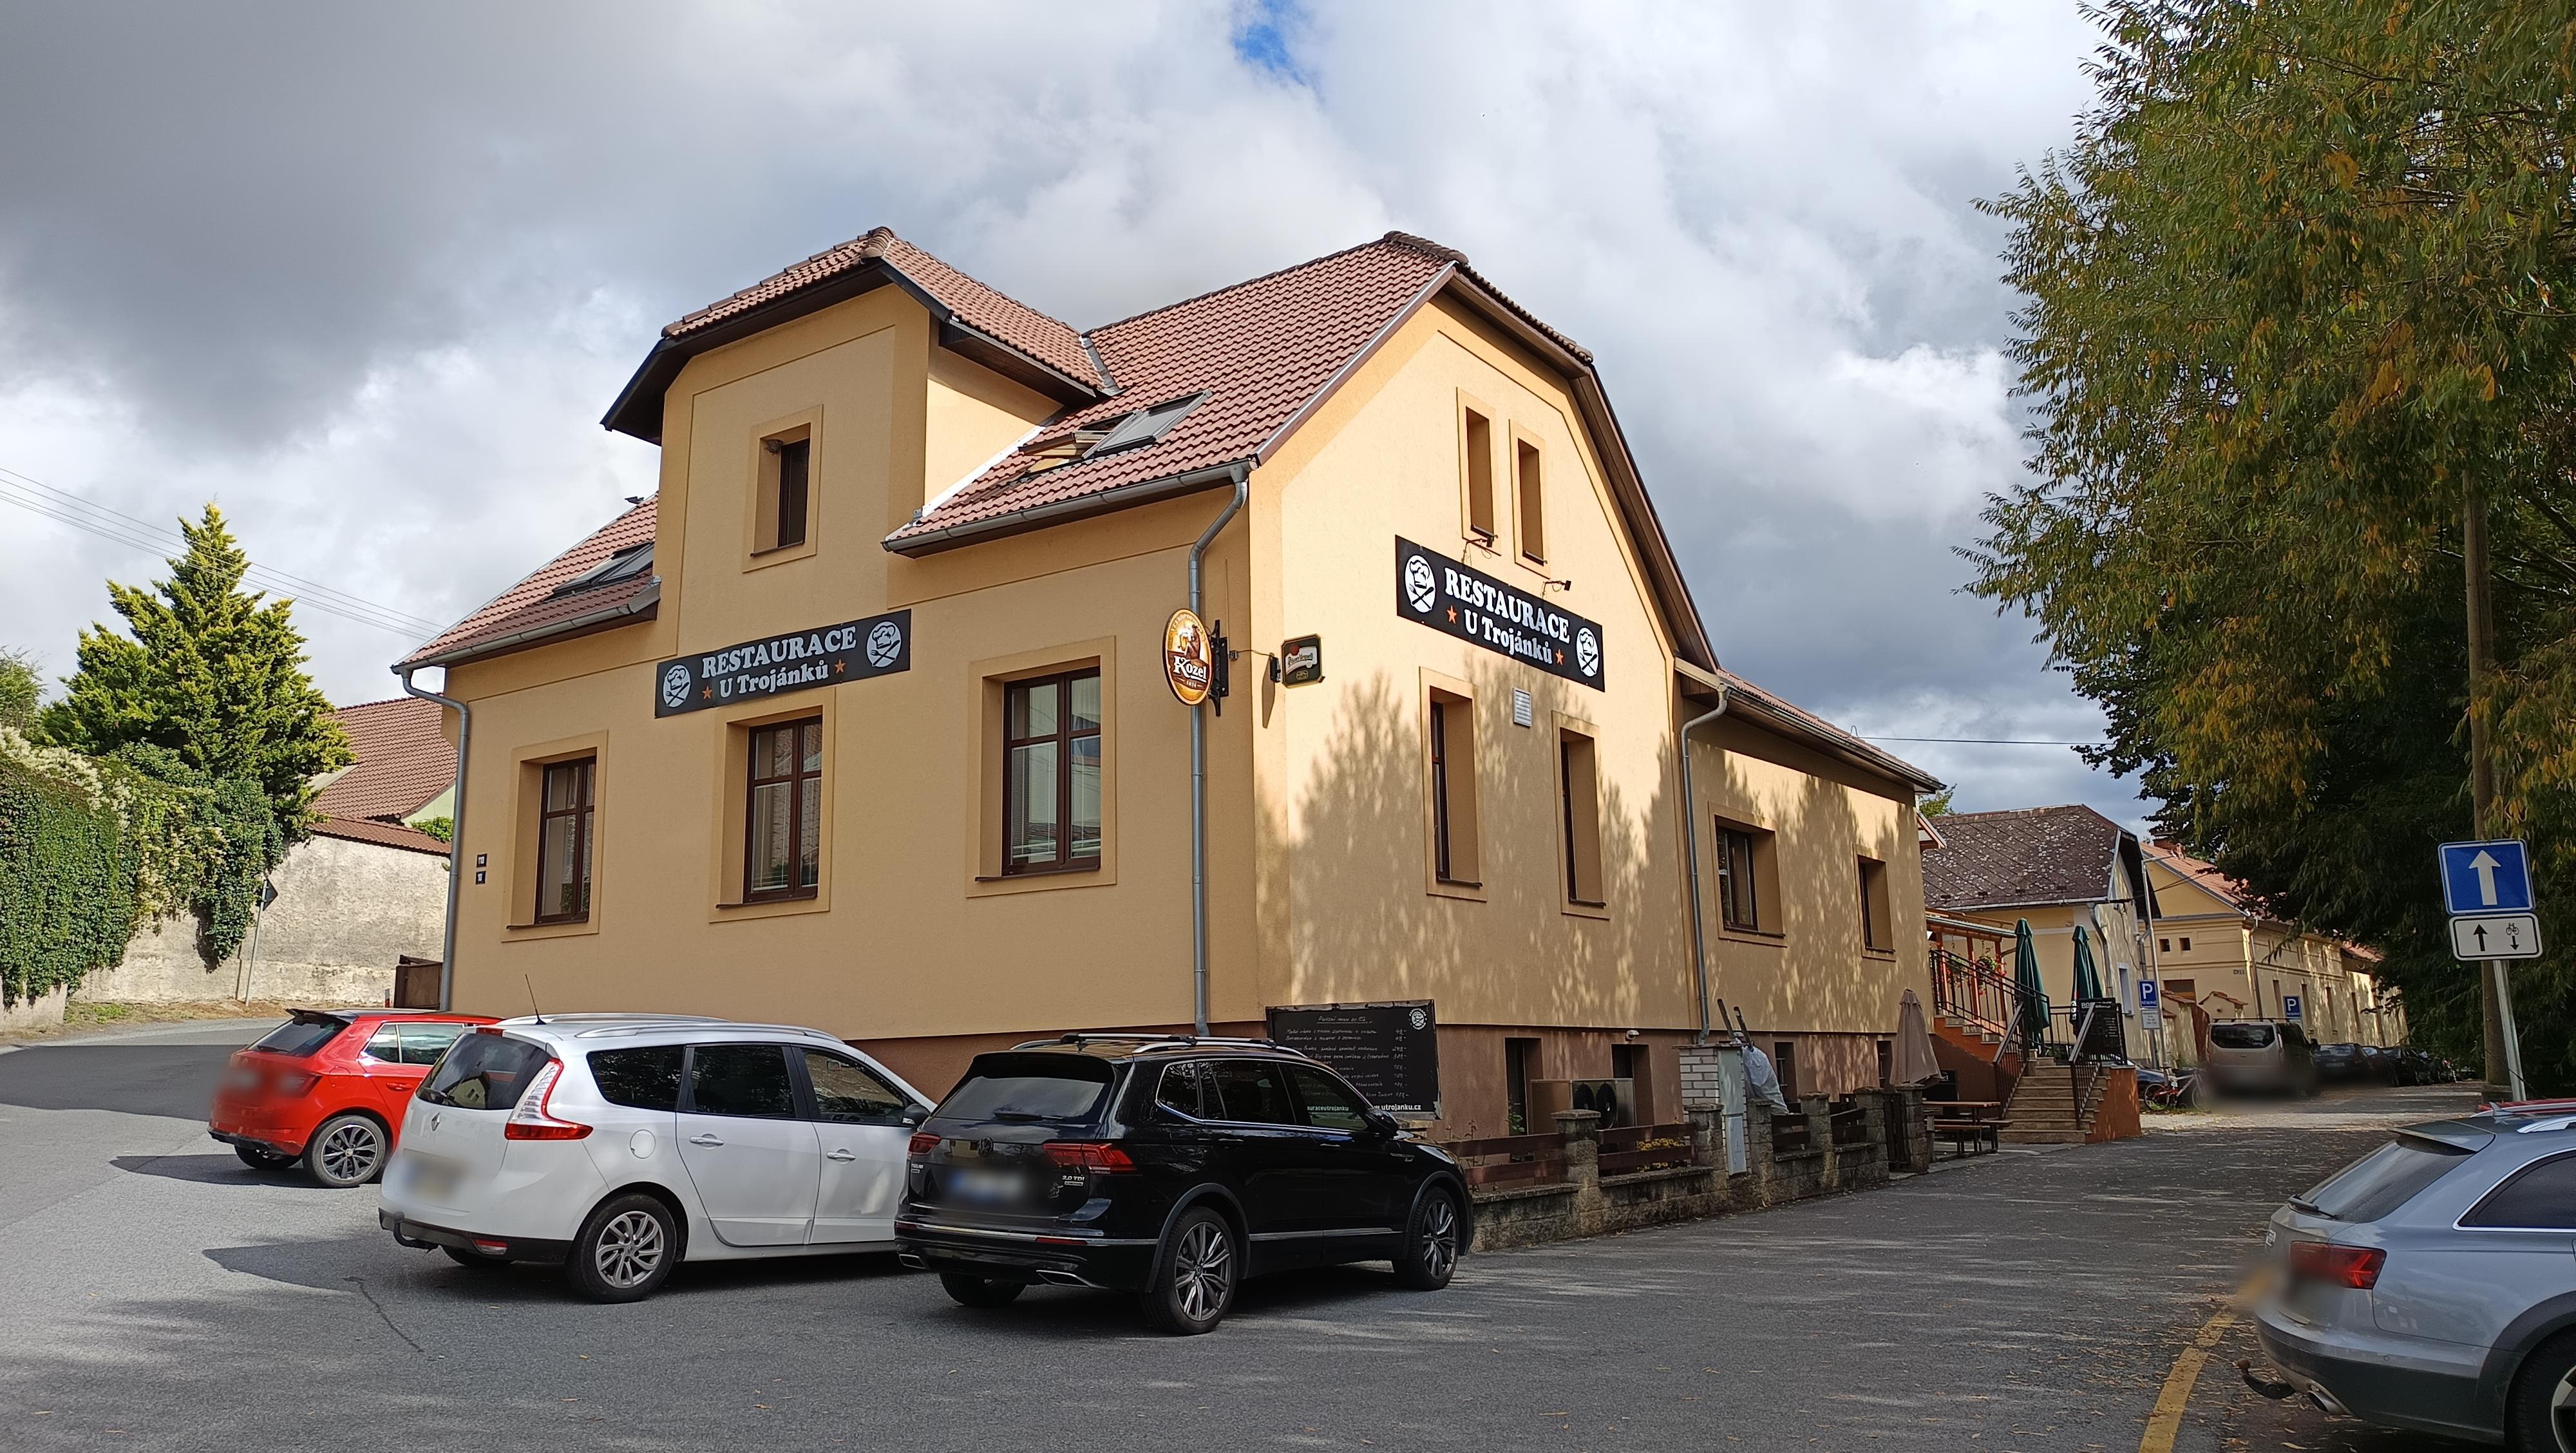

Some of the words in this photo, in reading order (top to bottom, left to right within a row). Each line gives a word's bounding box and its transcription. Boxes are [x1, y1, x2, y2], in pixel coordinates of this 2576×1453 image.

[1444, 567, 1570, 643] RESTAURACE
[701, 626, 857, 679] RESTAURACE
[1464, 609, 1478, 634] U
[1482, 616, 1553, 665] Trojánků
[719, 678, 733, 698] U
[737, 659, 829, 696] Trojánků
[1173, 655, 1207, 679] Kozel
[2141, 983, 2153, 1000] P
[2287, 998, 2297, 1011] P
